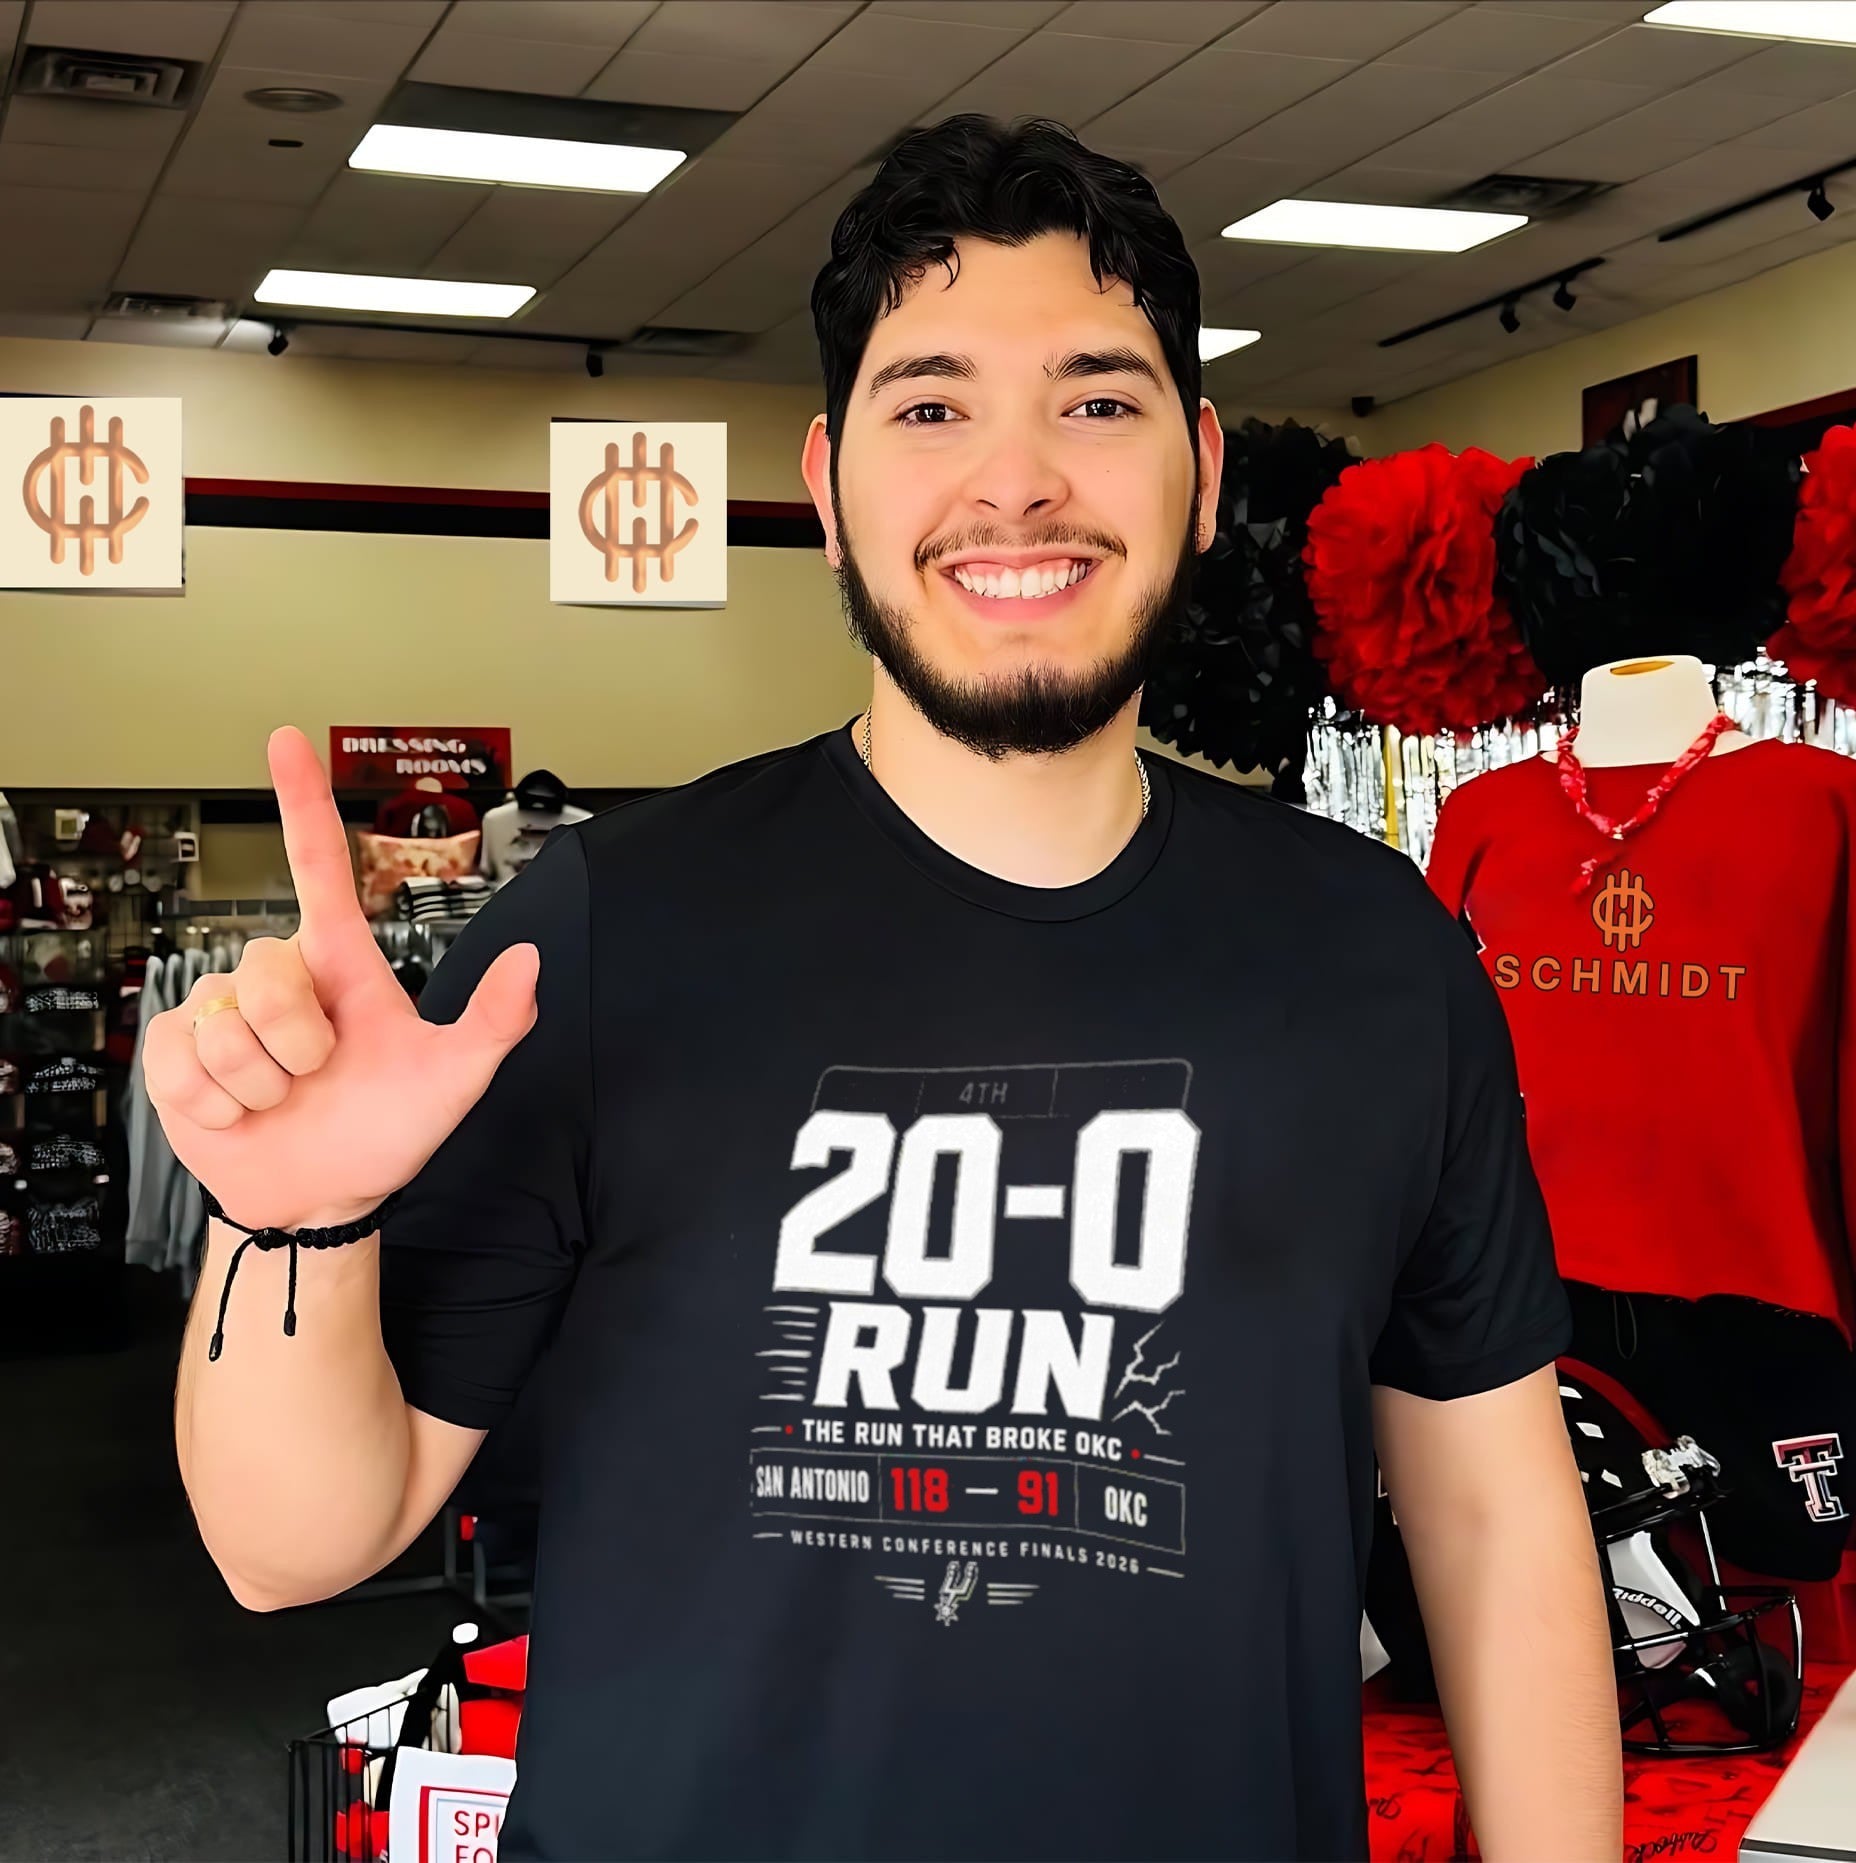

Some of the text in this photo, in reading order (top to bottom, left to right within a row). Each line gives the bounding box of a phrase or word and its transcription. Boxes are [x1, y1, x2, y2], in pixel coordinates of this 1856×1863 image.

[342, 737, 467, 754] DRESSING
[396, 758, 487, 775] ROOMS
[1494, 953, 1747, 1001] SCHMIDT
[958, 1081, 1009, 1105] 4TH
[773, 1109, 1202, 1315] 20-0
[812, 1301, 1116, 1421] RUN
[802, 1419, 1123, 1461] THE RUN THAT BROKE OKC
[755, 1465, 870, 1503] SAN ANTONIO
[890, 1467, 949, 1512] 118
[1017, 1470, 1059, 1516] 91
[1104, 1486, 1148, 1527] OKC
[790, 1530, 1140, 1574] WESTERN CONFERENCE FINALS 2026
